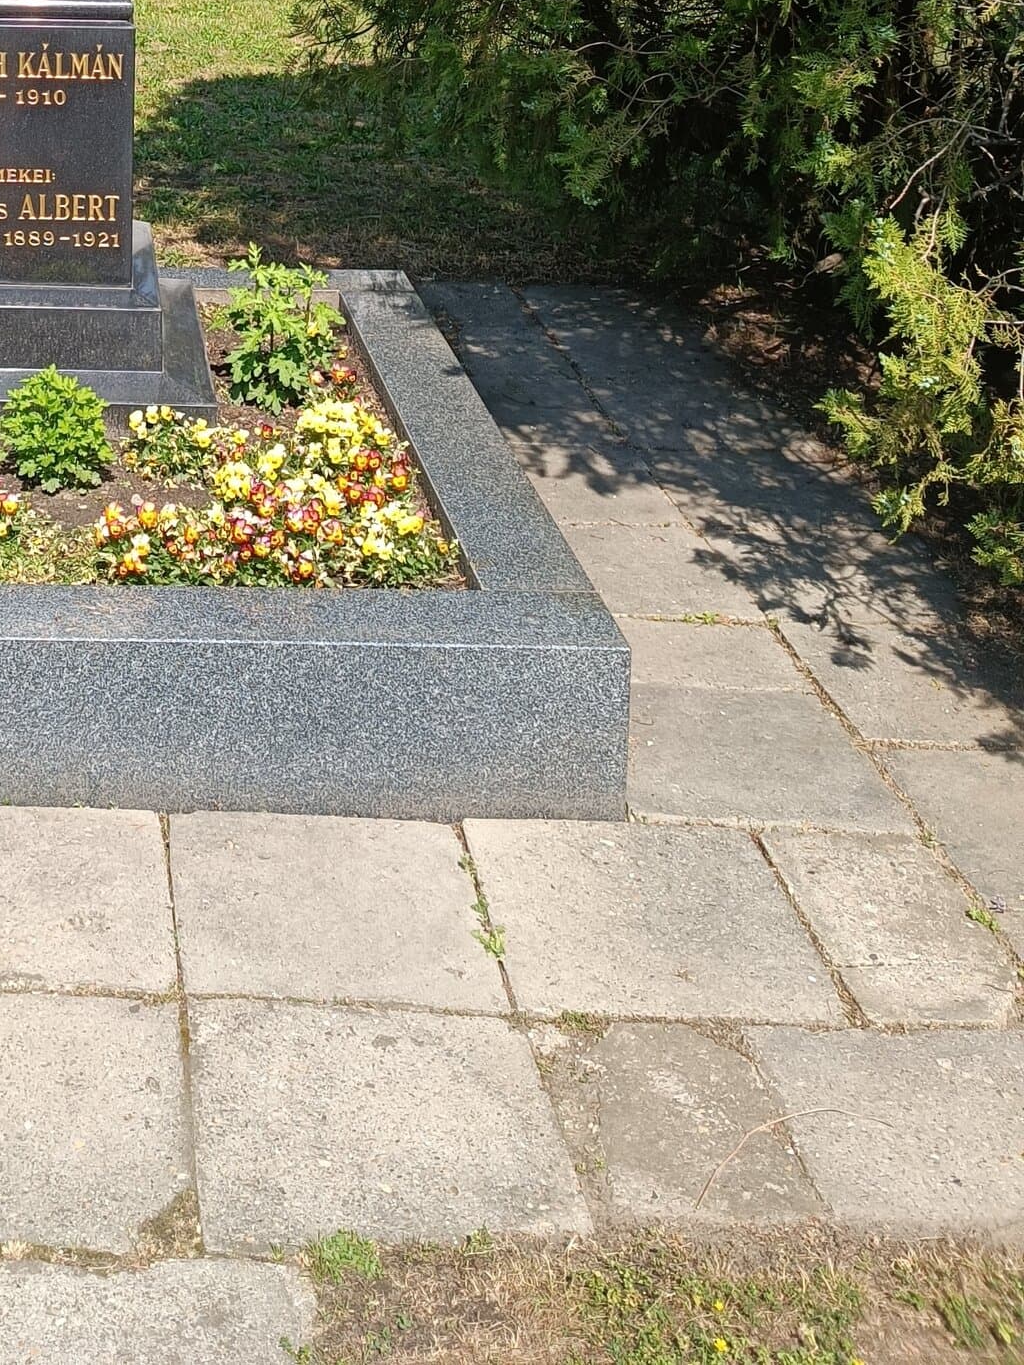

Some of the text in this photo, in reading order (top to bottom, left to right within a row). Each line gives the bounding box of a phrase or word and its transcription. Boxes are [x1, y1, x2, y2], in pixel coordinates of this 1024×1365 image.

[17, 44, 123, 80] KÁLMÁN
[15, 89, 66, 105] 1910
[18, 194, 120, 221] ALBERT
